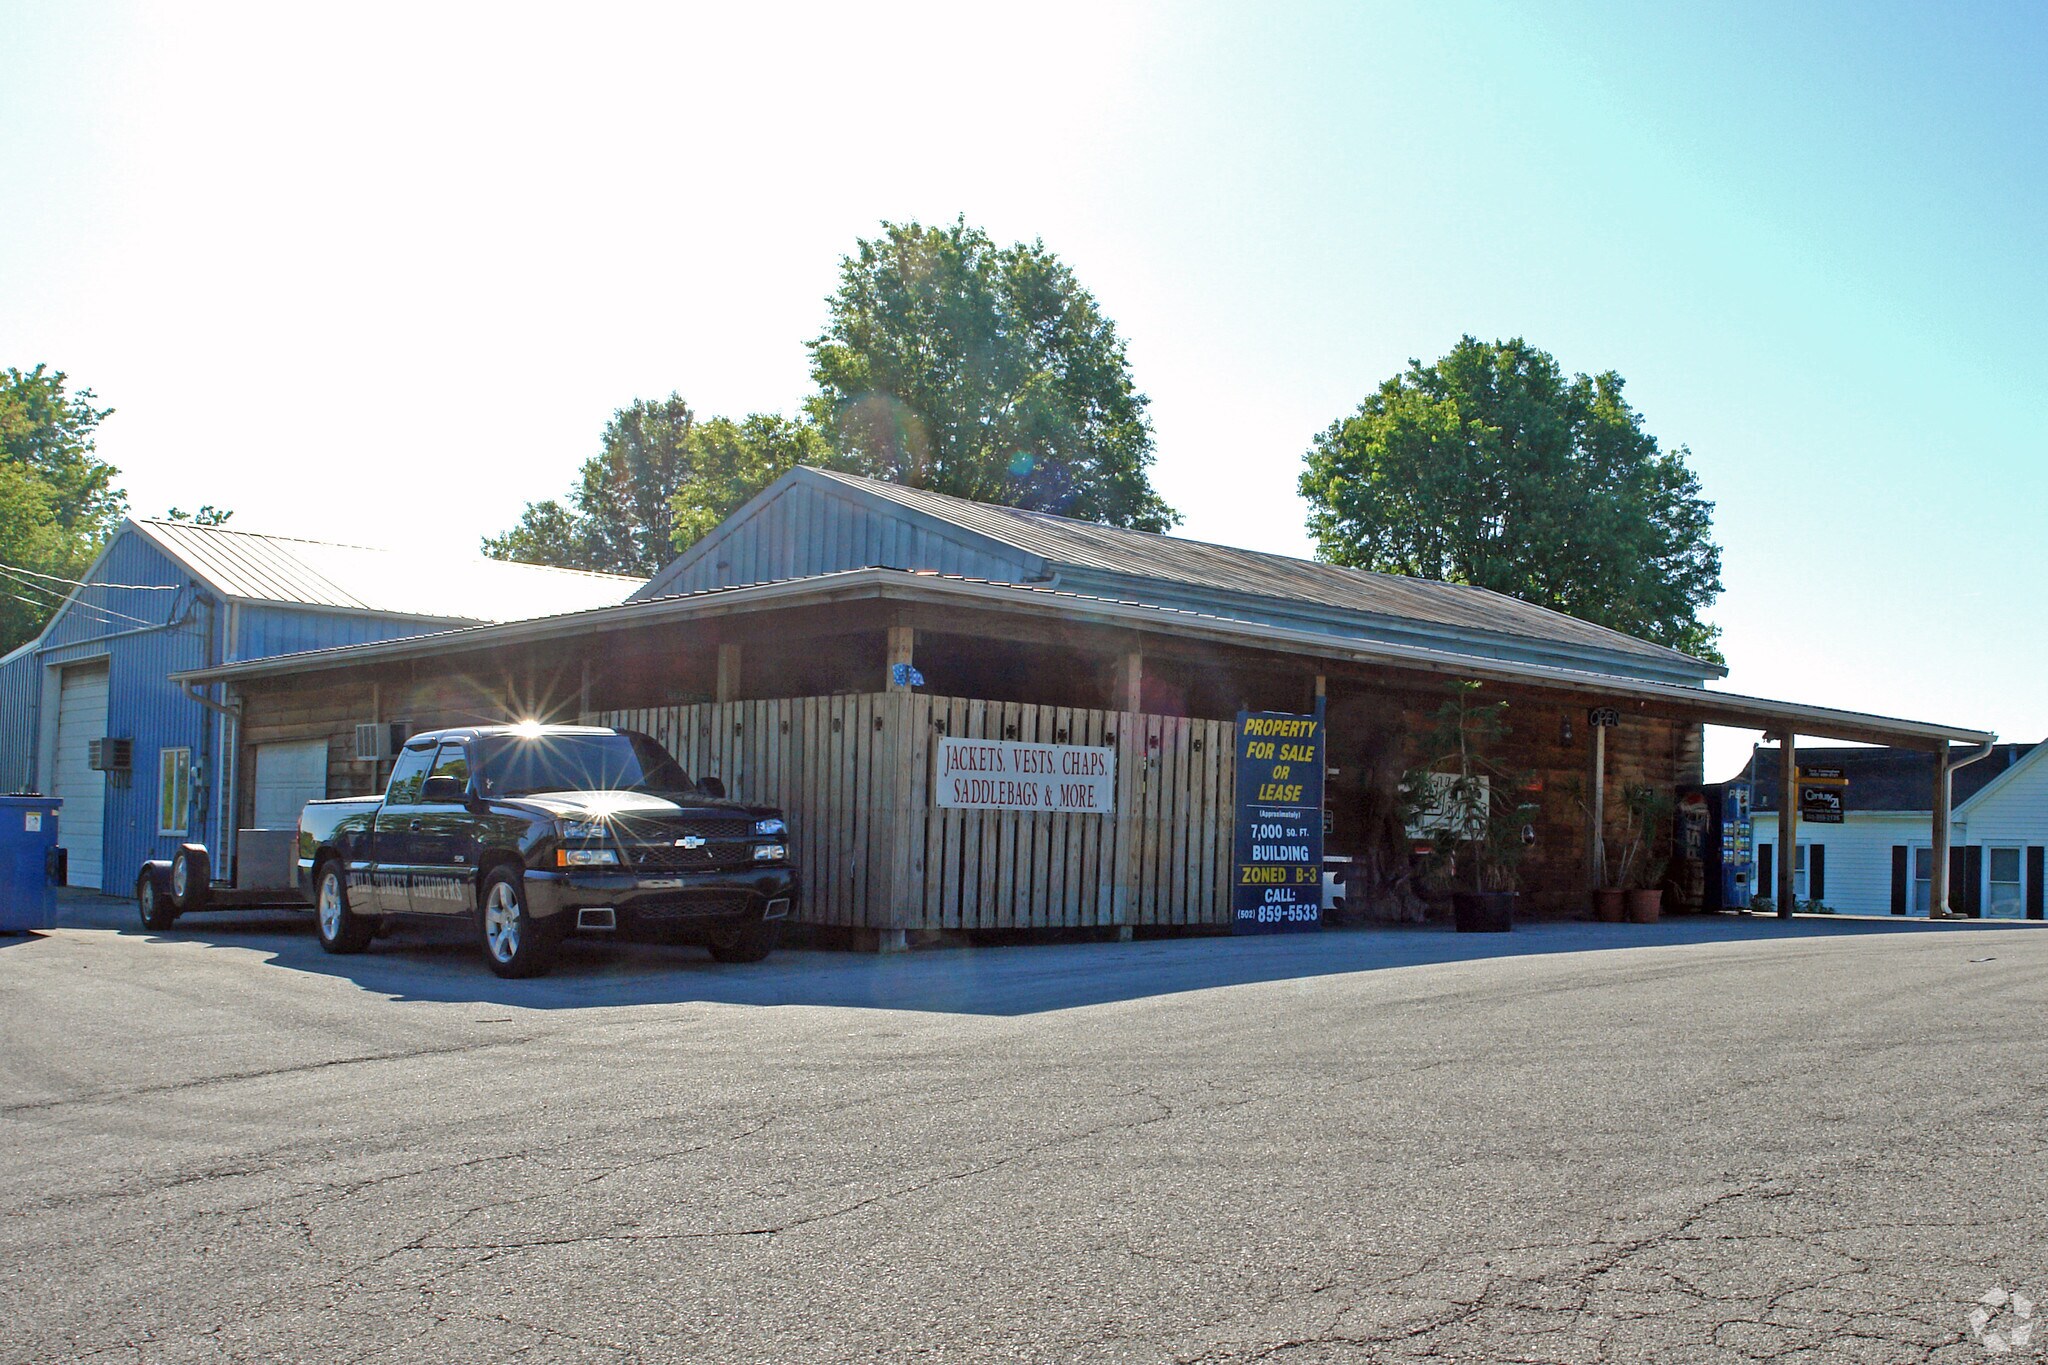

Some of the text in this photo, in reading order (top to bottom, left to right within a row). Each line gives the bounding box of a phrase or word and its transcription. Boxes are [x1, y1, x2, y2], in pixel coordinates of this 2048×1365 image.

[1590, 710, 1620, 726] OPEN
[1244, 718, 1318, 738] PROPERTY
[1246, 741, 1315, 762] FOR SALE
[1272, 765, 1290, 780] OR
[954, 778, 1097, 808] SADDLEBAGS & MORE.
[1258, 783, 1303, 802] LEASE
[1830, 797, 1840, 808] 21
[1260, 810, 1301, 819] (Approximately)
[1251, 824, 1310, 841] 7,000 SQ. FT.
[1252, 845, 1309, 861] BUILDING
[1242, 867, 1317, 883] ZONED B-3
[374, 873, 408, 896] TURKEY
[412, 874, 463, 901] CHOPPERS
[1264, 888, 1296, 903] CALL:
[1237, 904, 1318, 922] (502) 859-5533
